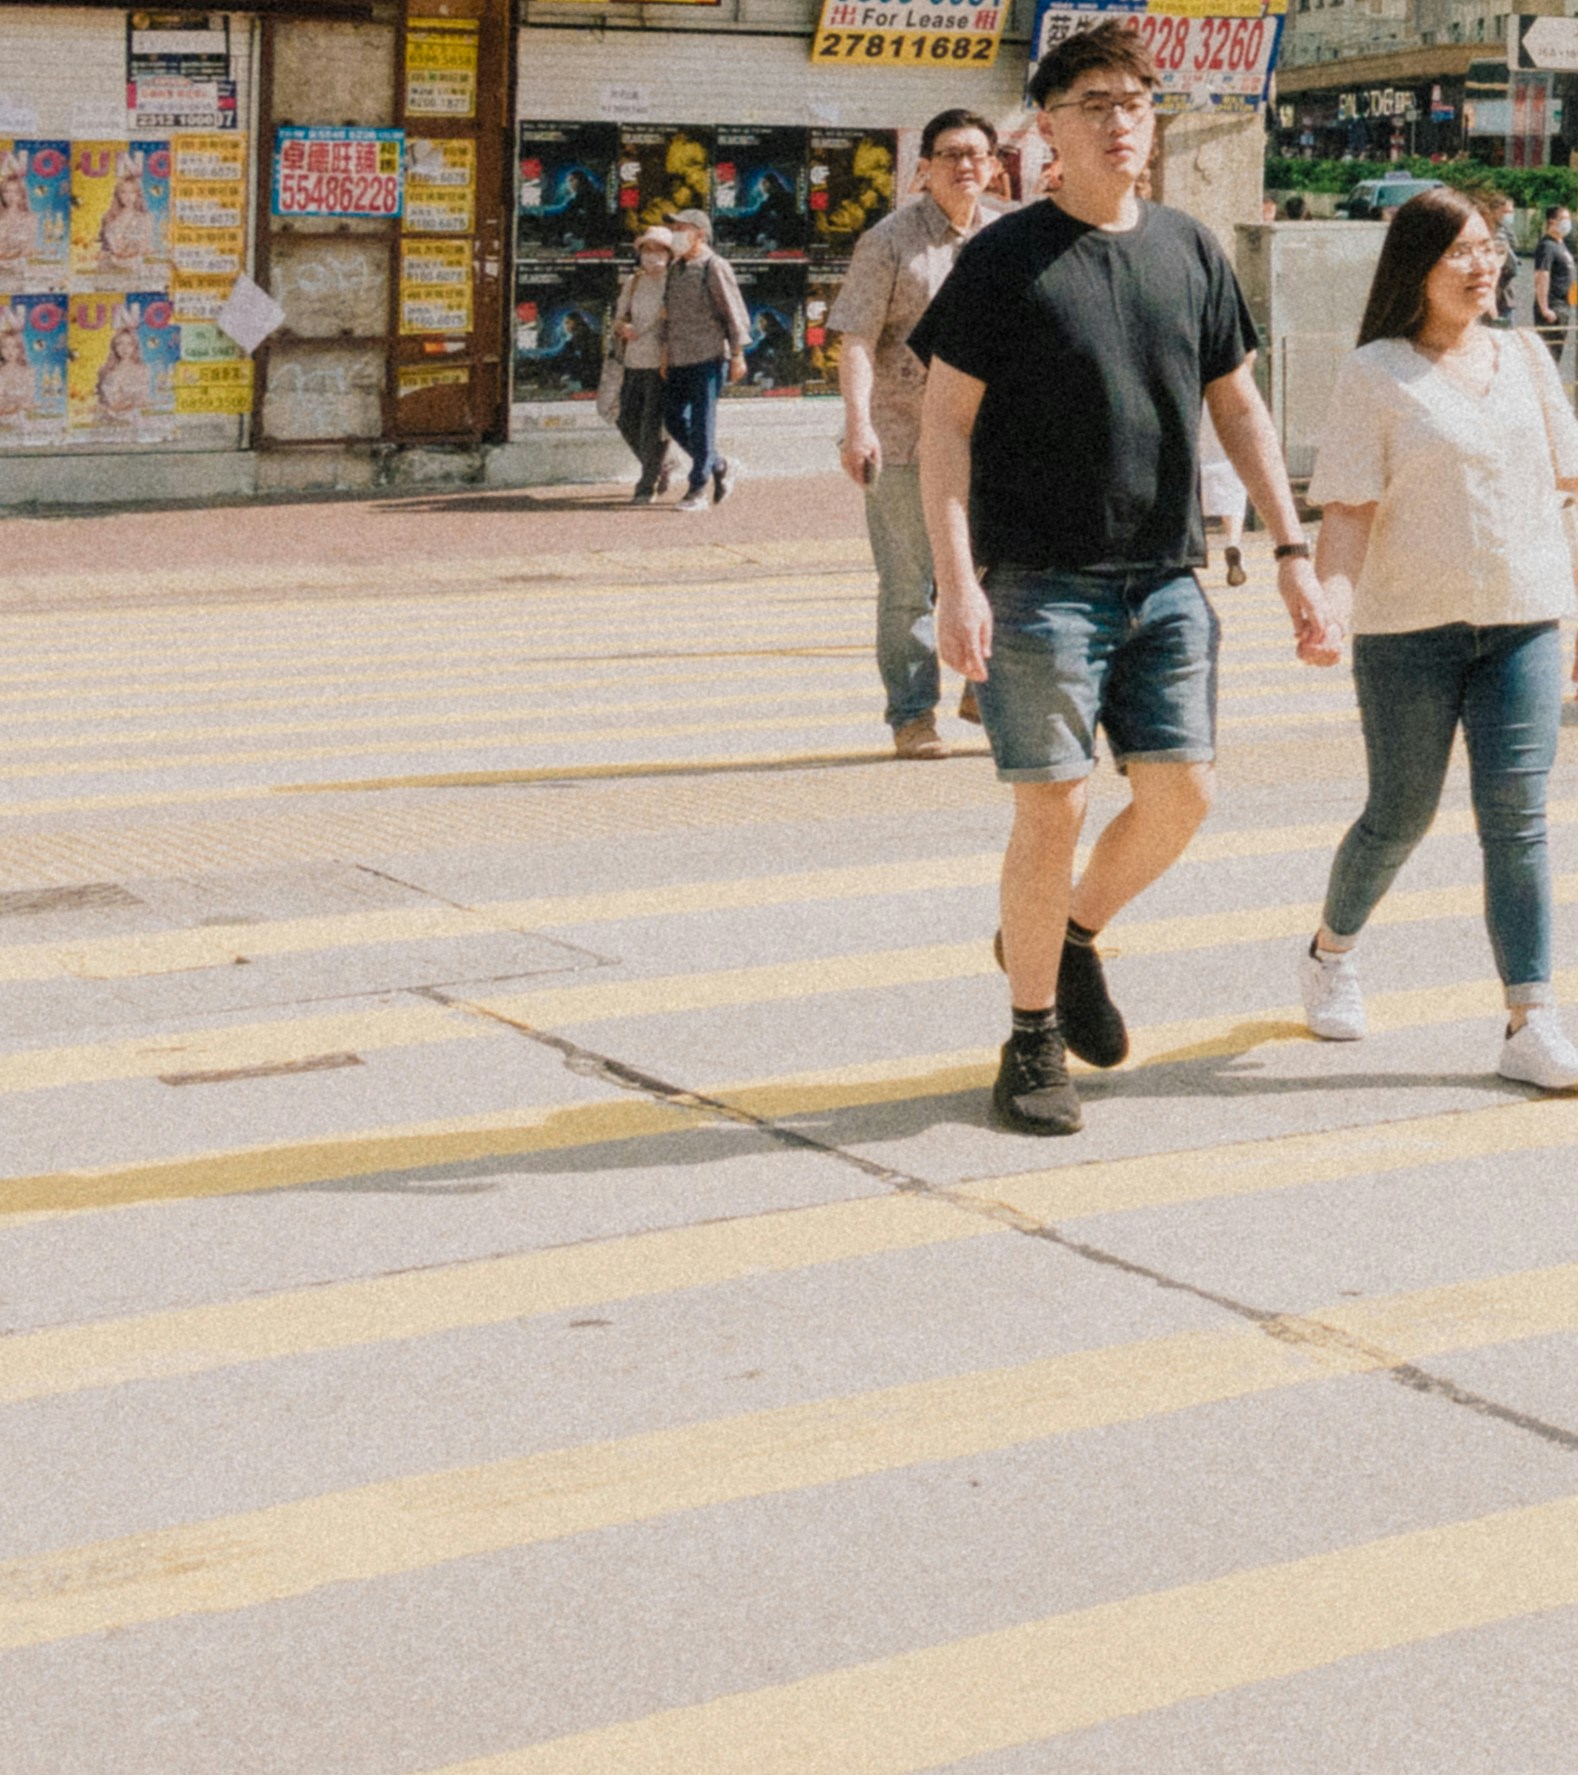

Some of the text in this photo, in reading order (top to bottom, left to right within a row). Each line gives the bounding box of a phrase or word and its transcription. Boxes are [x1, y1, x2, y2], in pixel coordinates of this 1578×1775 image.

[830, 5, 999, 31] 出 For Lease 租
[819, 33, 994, 60] 27811682
[1193, 16, 1265, 71] 3260
[79, 149, 173, 178] UNO
[281, 175, 398, 213] 55486228
[76, 300, 173, 330] UNO
